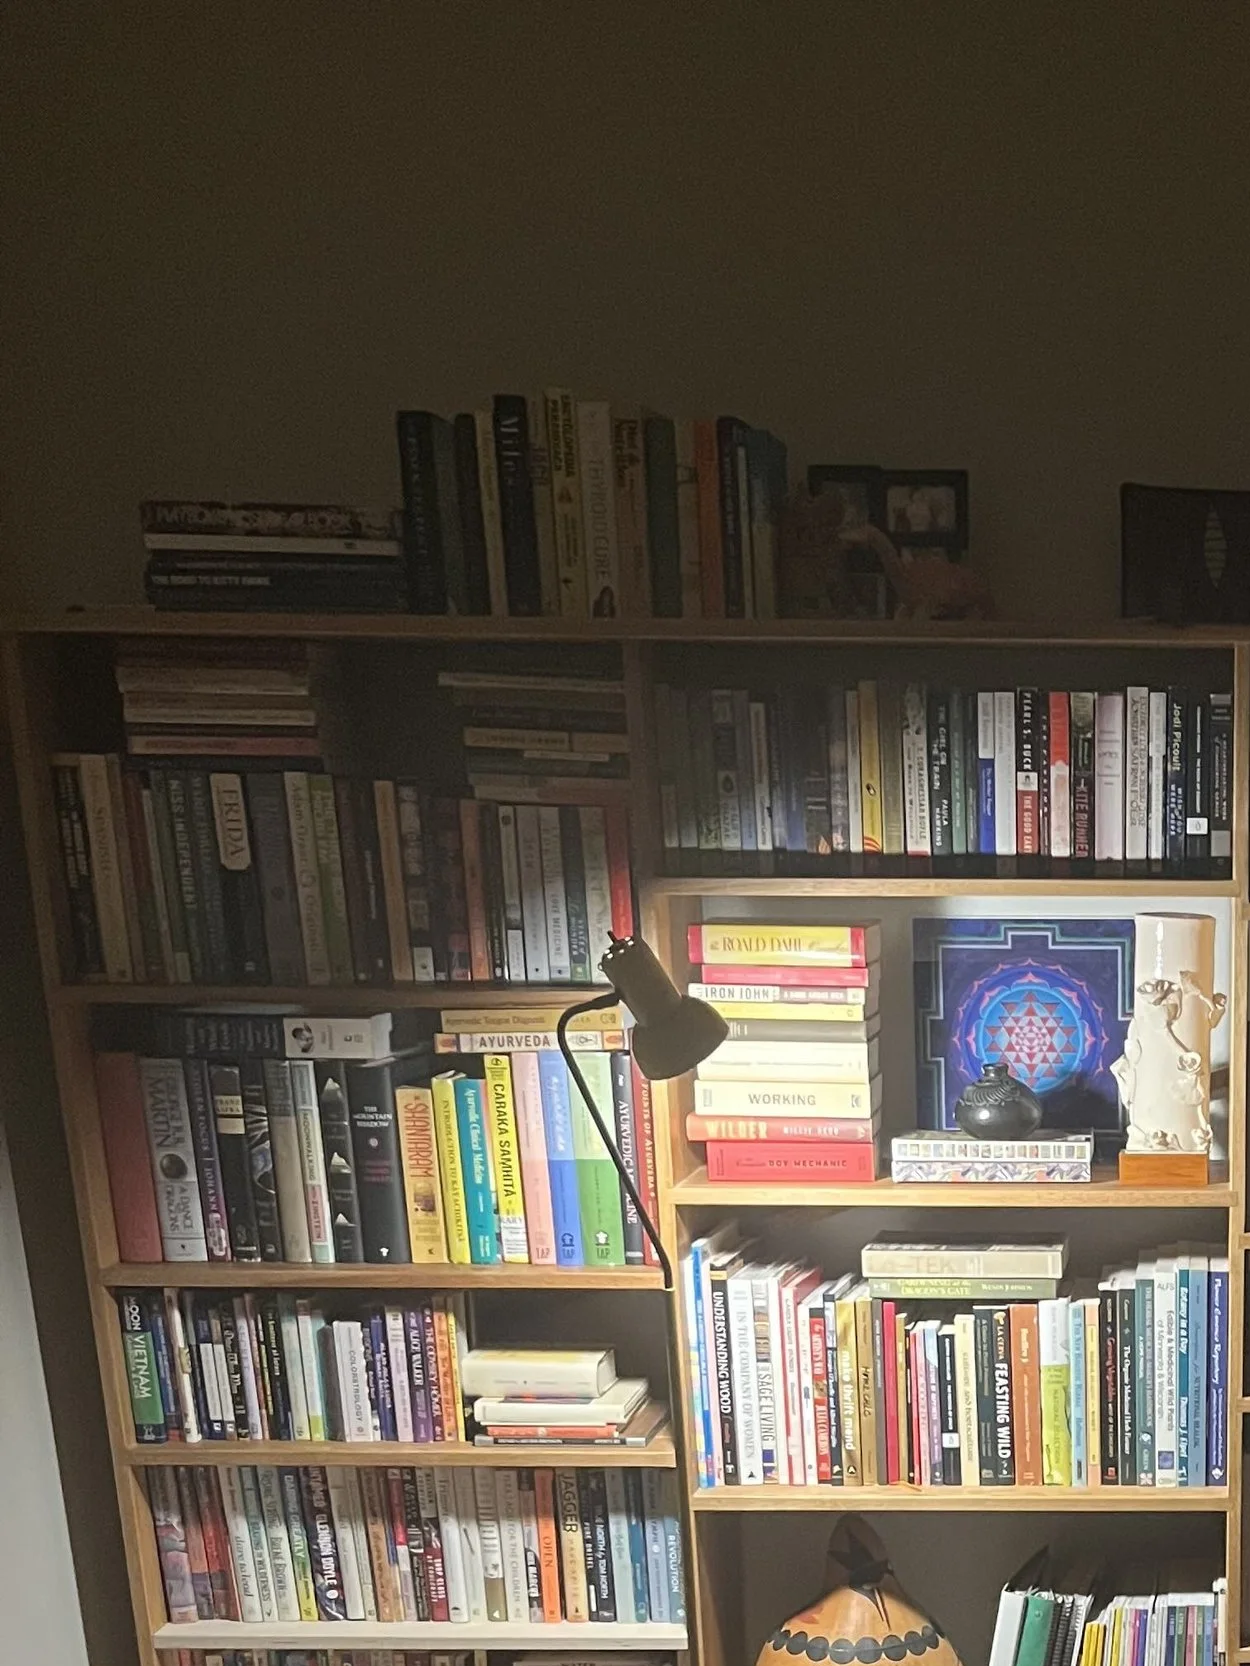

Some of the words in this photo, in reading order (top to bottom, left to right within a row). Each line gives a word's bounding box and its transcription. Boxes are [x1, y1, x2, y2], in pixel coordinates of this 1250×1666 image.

[594, 537, 611, 581] CURE
[1023, 692, 1032, 724] PEARL
[1172, 704, 1182, 728] Jodi
[1023, 744, 1032, 771] BUCK
[1172, 732, 1182, 772] Picoult
[941, 800, 949, 825] PAULA
[1075, 786, 1088, 810] KITE
[222, 789, 244, 858] FRIDA
[1023, 812, 1032, 833] GOOD
[1076, 812, 1089, 857] RUNNER
[723, 939, 766, 952] ROALD
[771, 939, 801, 952] DAHL
[705, 987, 735, 998] IRON
[740, 988, 769, 999] JOHN
[479, 1035, 550, 1047] AYURVEDA
[148, 1077, 171, 1148] MARTIN
[493, 1083, 507, 1136] CARAKA
[748, 1094, 817, 1106] WORKING
[198, 1115, 209, 1152] FOCUS
[405, 1103, 434, 1178] SHANTARAM
[443, 1101, 458, 1165] INTRODUCTION
[618, 1101, 632, 1165] AYURVEDIC
[705, 1121, 768, 1139] WILDER
[205, 1166, 218, 1211] JOHANN
[302, 1112, 316, 1181] MOONWALKING
[310, 1199, 323, 1239] EINSTEIN
[128, 1297, 141, 1330] MOON
[1179, 1286, 1188, 1317] Botany
[425, 1327, 433, 1343] THE
[712, 1291, 731, 1379] UNDERSTANDING
[997, 1326, 1003, 1336] LA
[1167, 1310, 1175, 1337] Edible
[1180, 1319, 1188, 1327] in
[409, 1329, 422, 1353] ALICE
[1106, 1337, 1115, 1365] Growing
[1123, 1346, 1131, 1358] The
[1179, 1337, 1188, 1354] Day
[135, 1335, 152, 1398] VIETNAM
[412, 1353, 424, 1386] WALKER
[426, 1345, 436, 1382] ODYSSEY
[740, 1351, 753, 1399] COMPANY
[841, 1350, 851, 1381] make
[1123, 1359, 1132, 1384] Organic
[1167, 1348, 1175, 1386] Medicinal
[430, 1385, 441, 1417] HOMER
[720, 1379, 732, 1414] WOOD
[759, 1374, 773, 1402] SAGE
[842, 1384, 853, 1415] thrift
[995, 1363, 1010, 1424] FEASTING
[1167, 1388, 1176, 1406] Wild
[743, 1404, 753, 1418] OF
[760, 1404, 775, 1443] LIVING
[1167, 1407, 1176, 1431] Plants
[1180, 1396, 1188, 1427] Thomas
[745, 1420, 756, 1459] WOMEN
[844, 1418, 855, 1450] mend
[996, 1426, 1012, 1459] WILD
[284, 1475, 298, 1513] DARING
[560, 1472, 578, 1532] JAGGER
[290, 1514, 305, 1559] GREATLY
[583, 1522, 592, 1541] PURE
[595, 1524, 606, 1550] NORTH
[510, 1543, 518, 1559] THE
[542, 1536, 553, 1567] OPEN
[667, 1534, 680, 1592] REVOLUTION
[274, 1563, 286, 1591] BROWN
[323, 1557, 337, 1586] DOYLE
[511, 1561, 520, 1602] CHILDREN
[600, 1576, 609, 1599] NORTH
